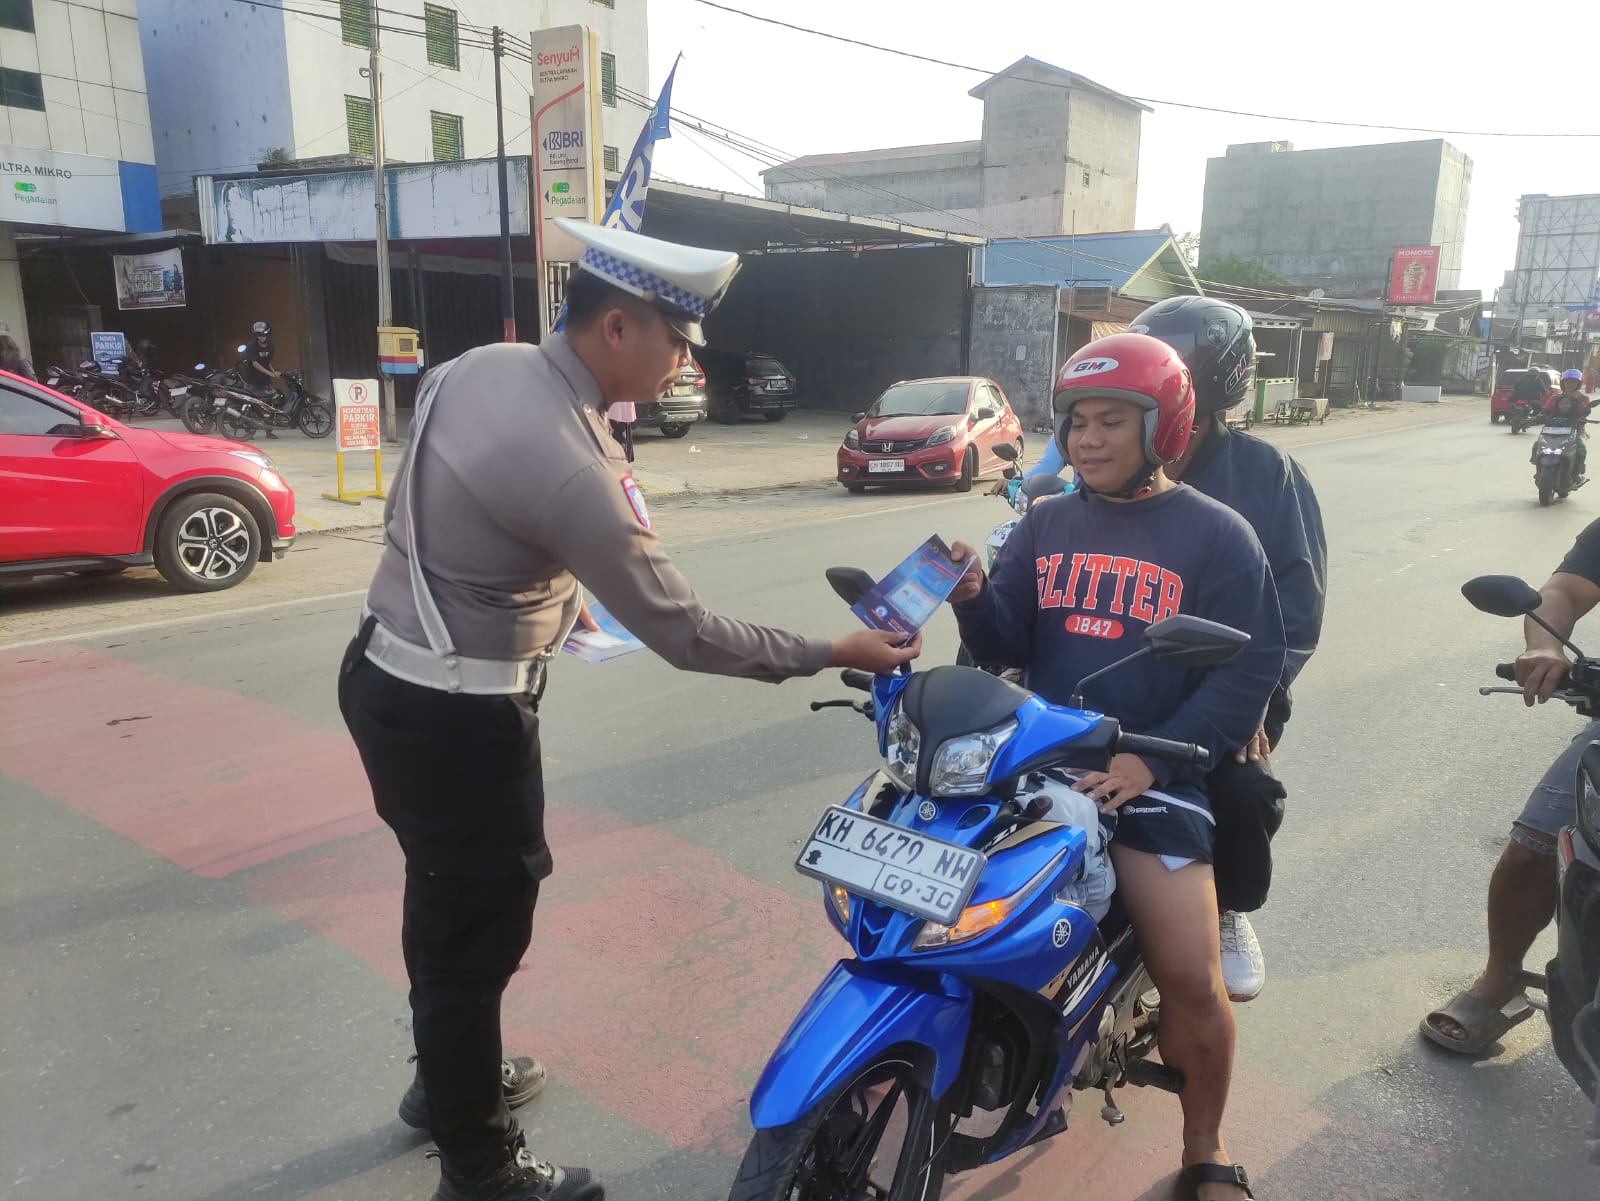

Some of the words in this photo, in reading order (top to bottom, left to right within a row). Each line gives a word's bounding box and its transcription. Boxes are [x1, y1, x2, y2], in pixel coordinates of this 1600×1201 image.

[562, 131, 584, 149] BRI
[35, 166, 72, 179] MIKRO
[14, 193, 58, 206] Pegadaian
[551, 195, 586, 206] Pegadaian
[95, 341, 123, 350] PARKIR
[1073, 361, 1107, 372] GM
[1224, 352, 1248, 395] GM
[343, 413, 375, 422] PARKIR
[1073, 616, 1113, 637] 1847
[818, 812, 855, 843] KH
[933, 848, 976, 883] NW
[1066, 945, 1100, 990] YAMAHA
